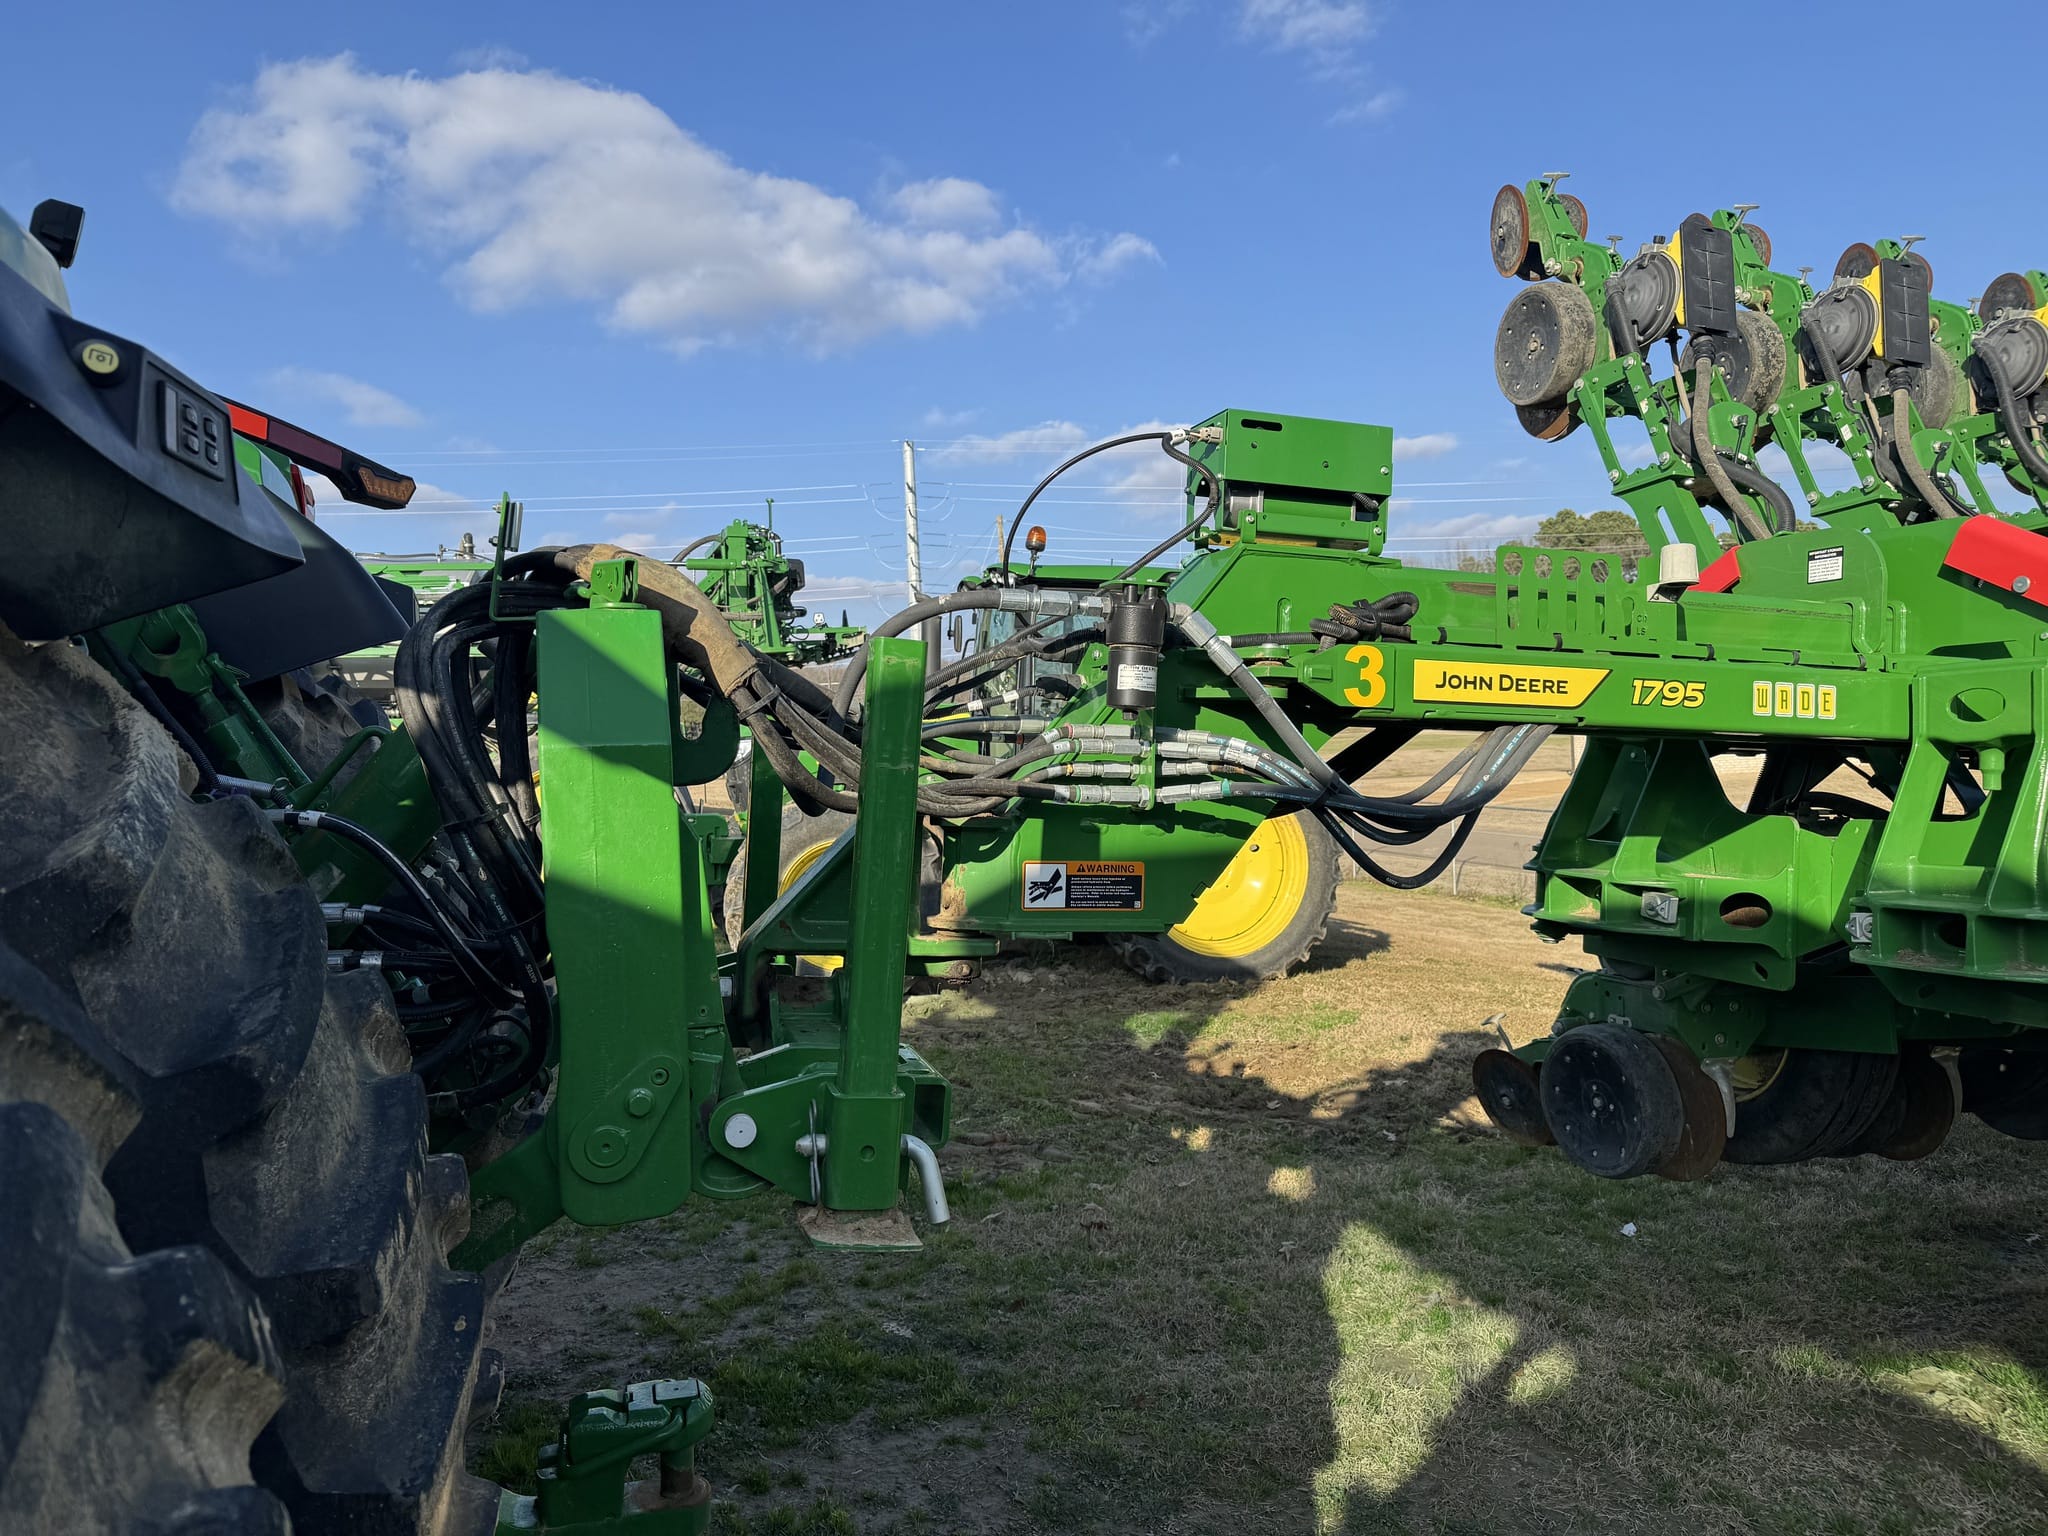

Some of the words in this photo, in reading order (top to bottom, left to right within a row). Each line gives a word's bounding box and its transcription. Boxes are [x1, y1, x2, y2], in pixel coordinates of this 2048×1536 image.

[1344, 645, 1385, 707] 3
[1435, 671, 1493, 692] JOHN
[1498, 674, 1569, 695] DEERE
[1631, 679, 1706, 708] 1795
[1754, 682, 1835, 717] WADE
[1087, 864, 1135, 873] WARNING
